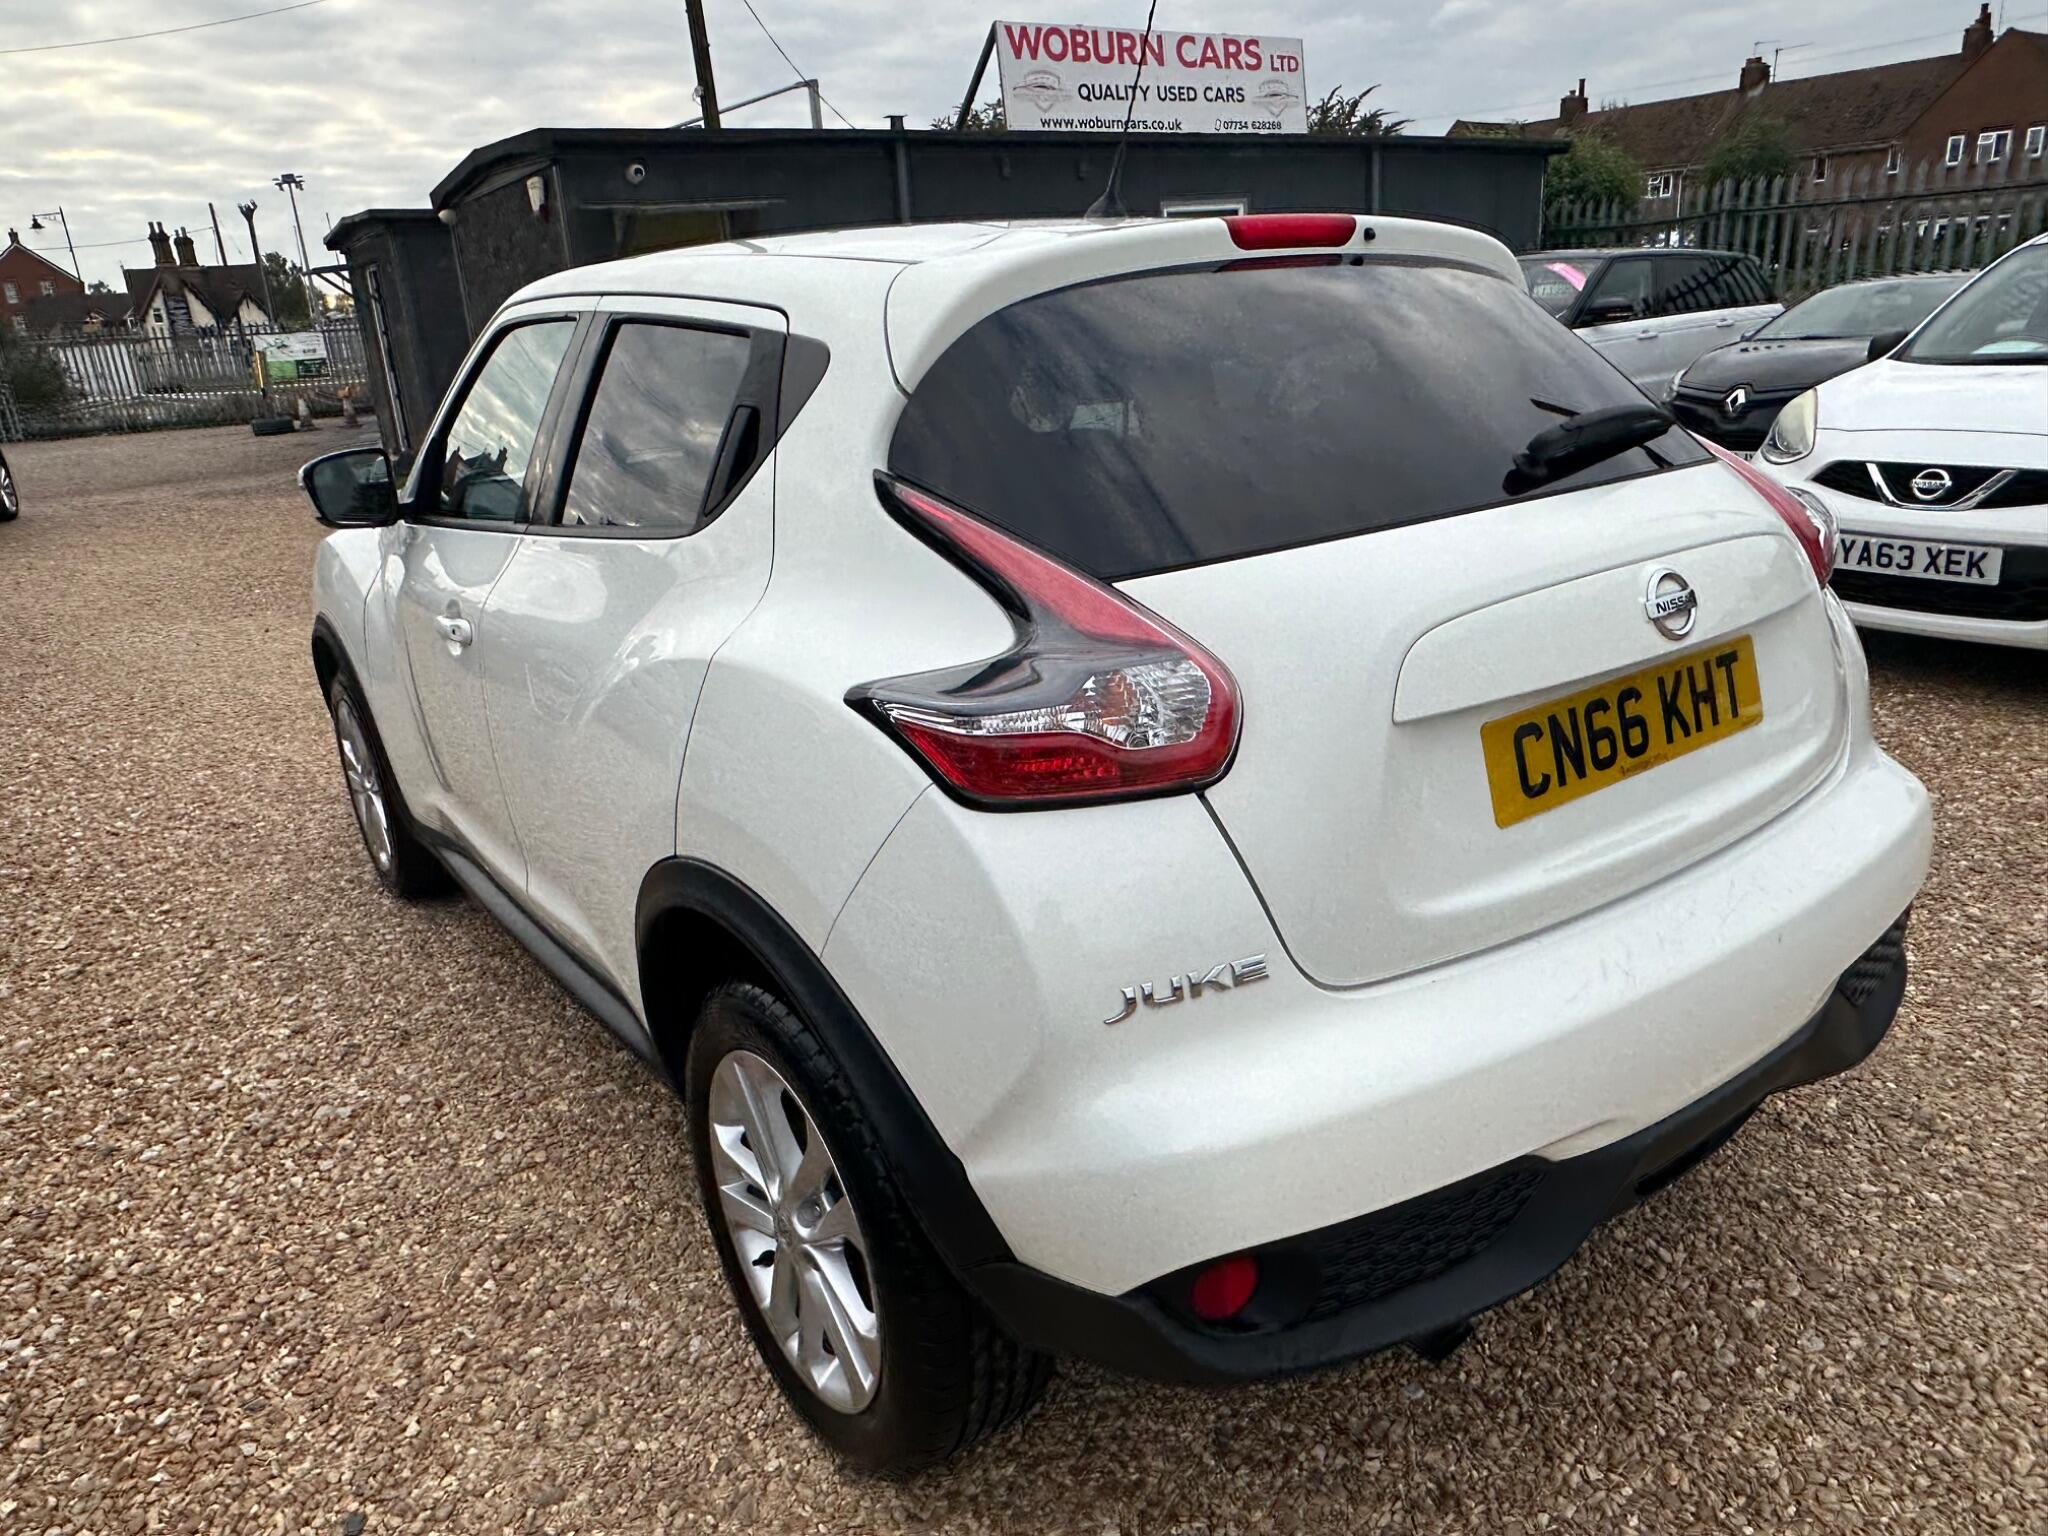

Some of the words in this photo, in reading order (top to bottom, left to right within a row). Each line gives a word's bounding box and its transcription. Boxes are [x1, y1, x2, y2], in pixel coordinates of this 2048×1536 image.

[1004, 25, 1165, 67] WOBURN
[1175, 35, 1262, 71] CARS
[1270, 54, 1299, 72] LTD
[1078, 83, 1149, 101] QUALITY
[1156, 85, 1197, 101] USED
[1203, 86, 1245, 103] CARS
[1040, 116, 1182, 131] www.woburncars.co.uk
[1840, 538, 1914, 571] YA63
[1923, 546, 1989, 579] XEK
[1513, 687, 1650, 799] CN66
[1657, 650, 1739, 745] KHT
[1103, 953, 1270, 1025] JUKE
